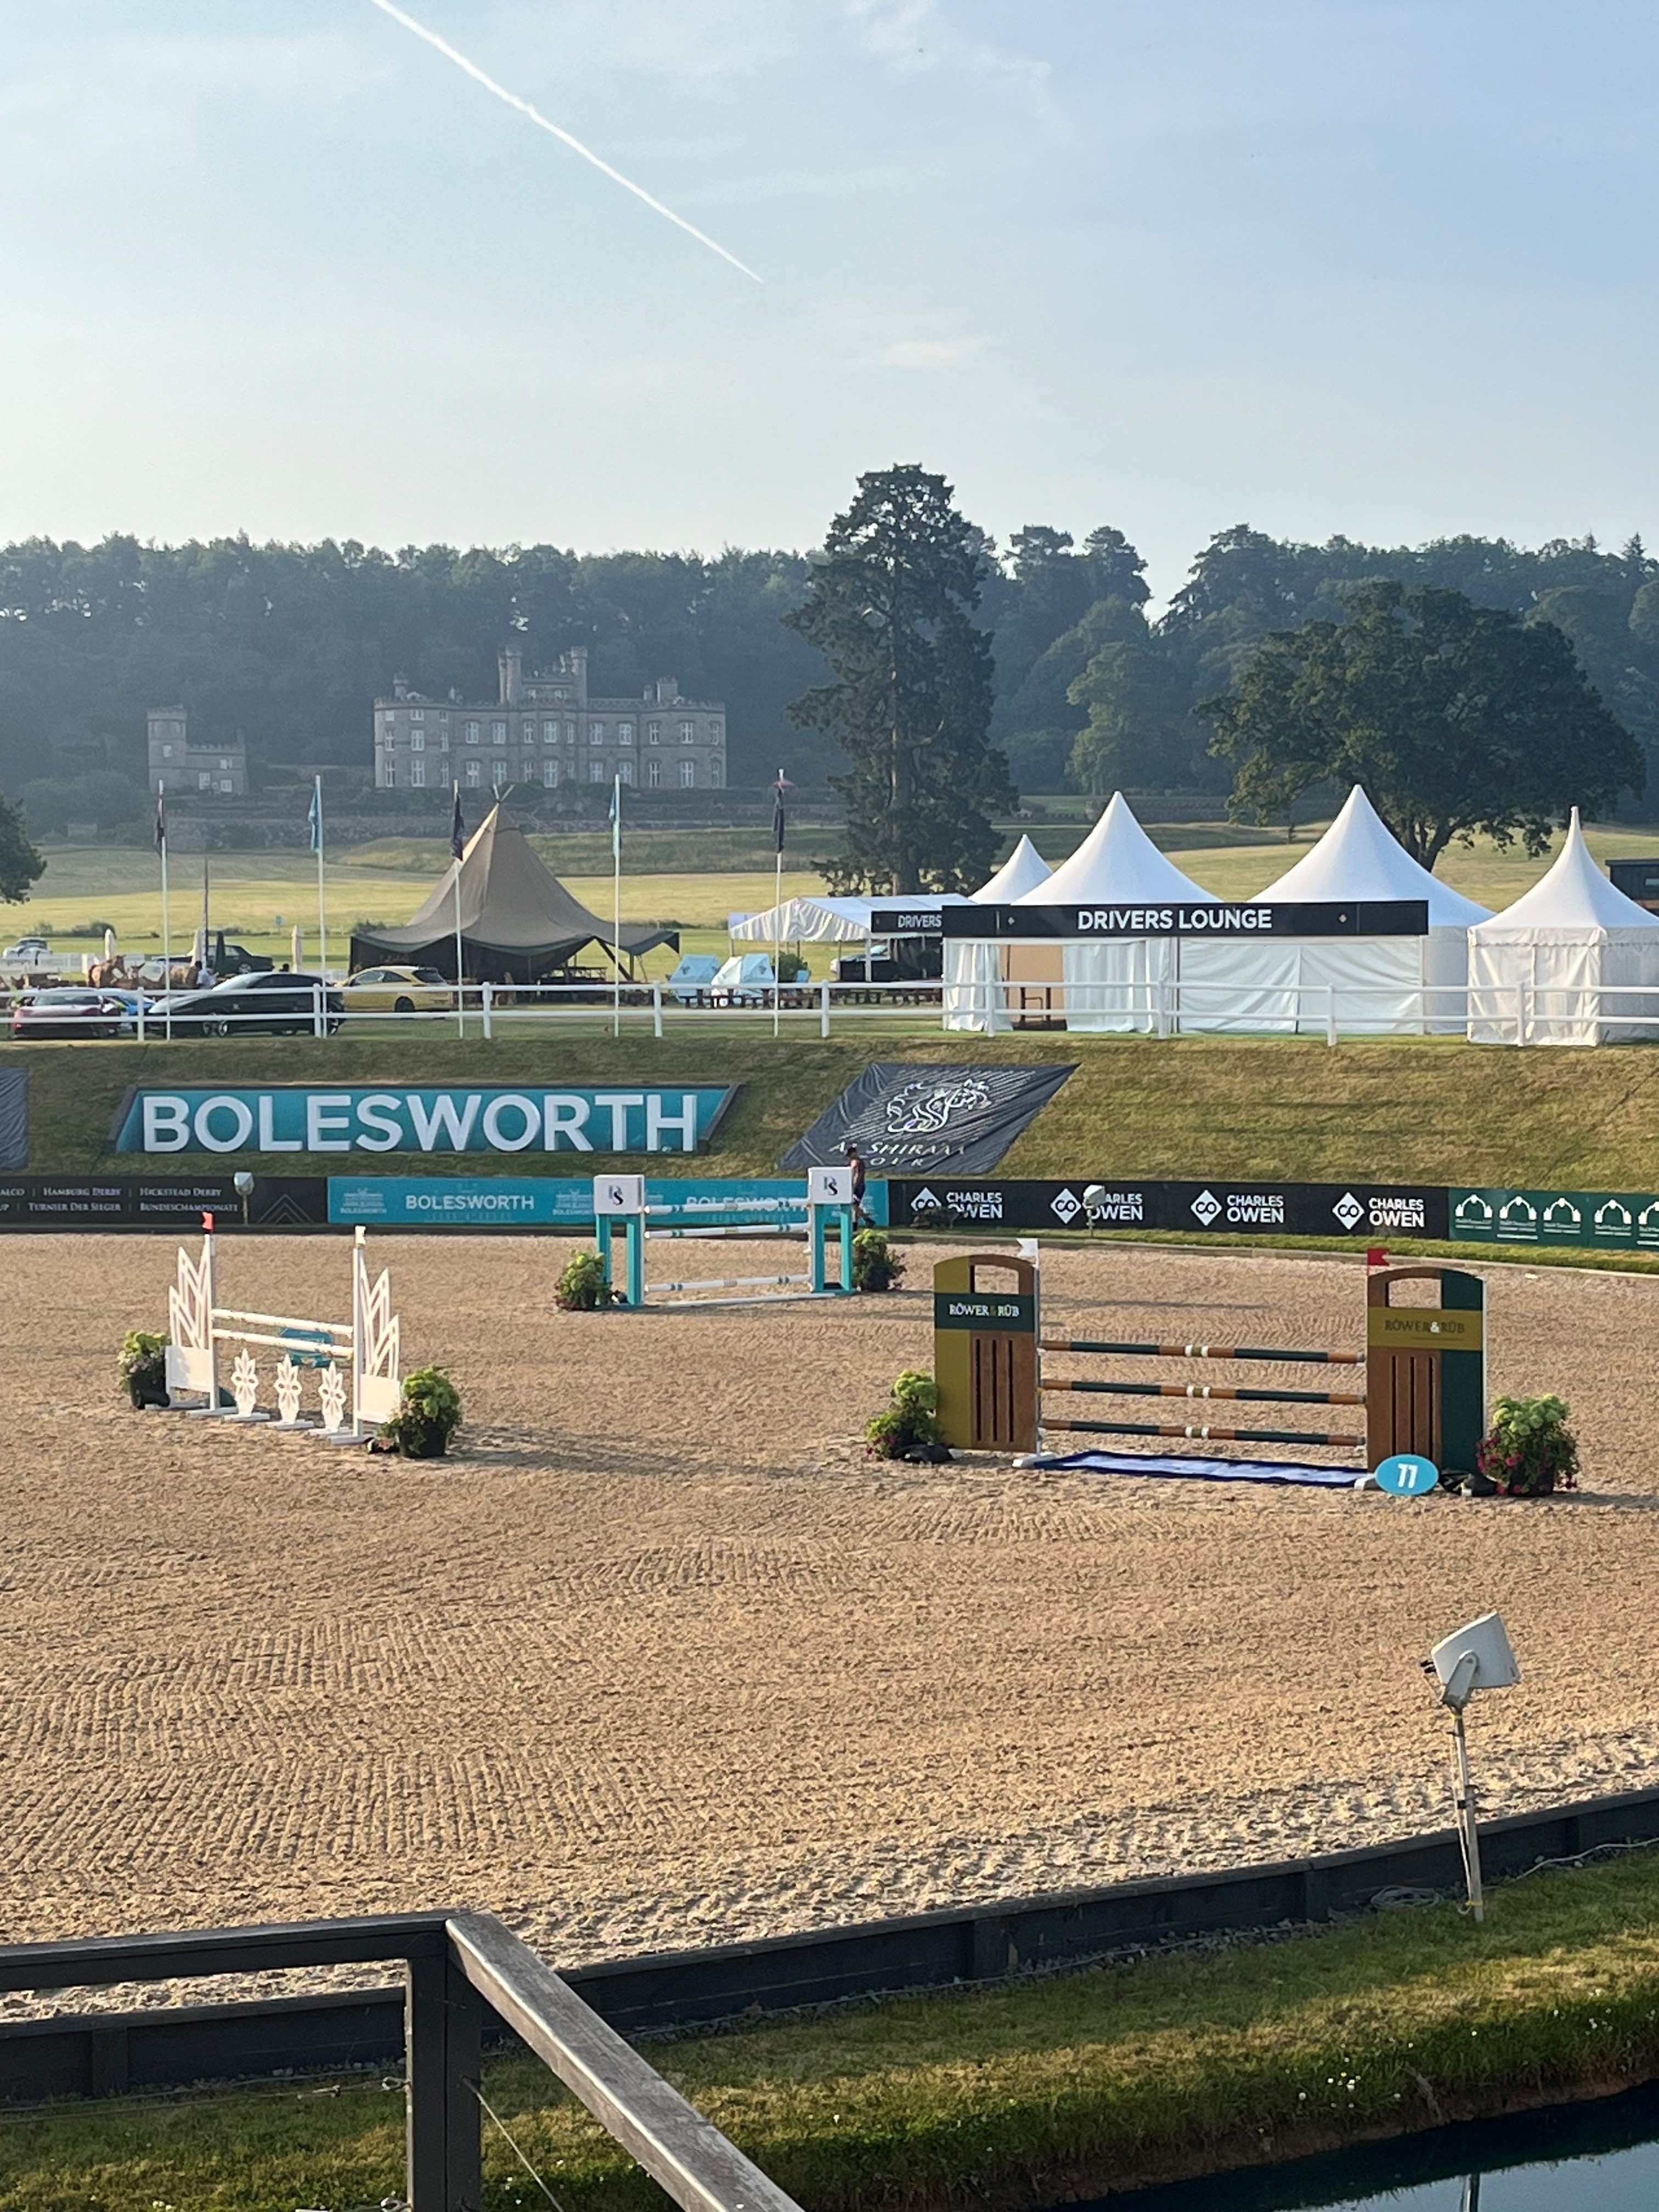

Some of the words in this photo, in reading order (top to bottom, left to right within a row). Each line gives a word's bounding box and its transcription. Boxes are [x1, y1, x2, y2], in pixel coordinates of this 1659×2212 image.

[898, 915, 942, 928] DRIVERS
[1077, 910, 1173, 929] DRIVERS
[1179, 909, 1272, 929] LOUNGE
[143, 1094, 697, 1153] BOLESWORTH
[406, 1195, 534, 1210] BOLESWORTH
[946, 1192, 1003, 1203] CHARLES
[1105, 1193, 1143, 1205] ARLES
[1227, 1195, 1284, 1207] CHARLES
[1368, 1198, 1424, 1211] CHARLES
[1227, 1207, 1284, 1223] OWEN
[1369, 1211, 1425, 1227] OWEN
